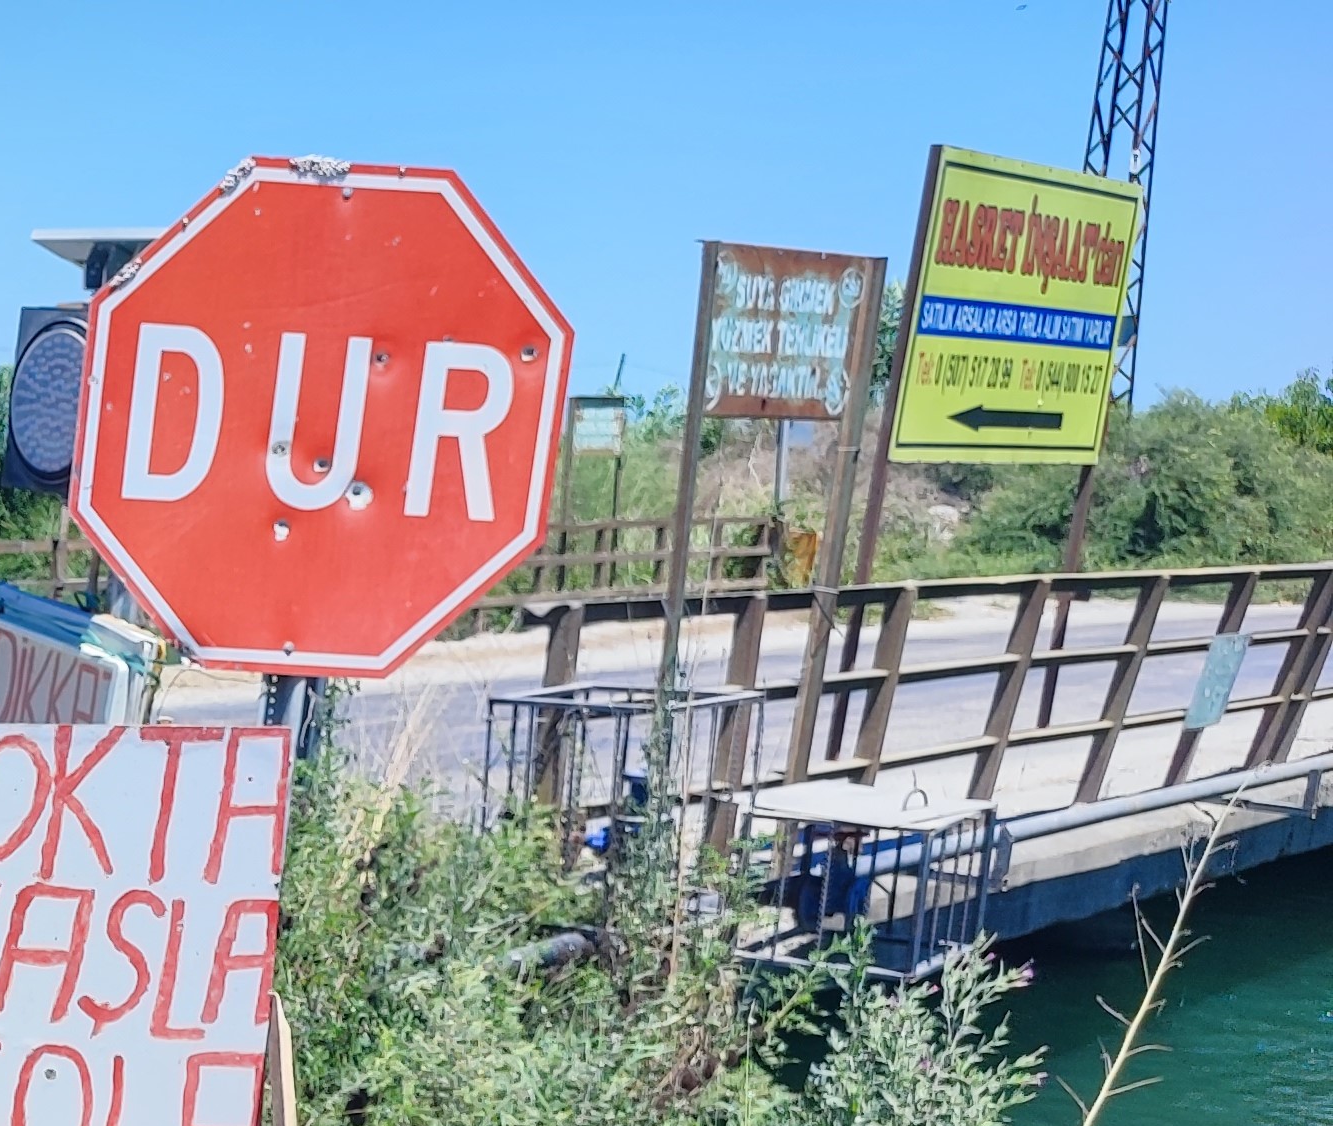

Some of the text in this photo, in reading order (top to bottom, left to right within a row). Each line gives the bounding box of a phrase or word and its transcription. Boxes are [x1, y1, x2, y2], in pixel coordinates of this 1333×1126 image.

[935, 198, 1025, 273] HASRET
[953, 304, 995, 334] ARSALAR
[994, 308, 1018, 336] ARSA
[1018, 311, 1043, 339] TARLA
[120, 322, 514, 522] DUR
